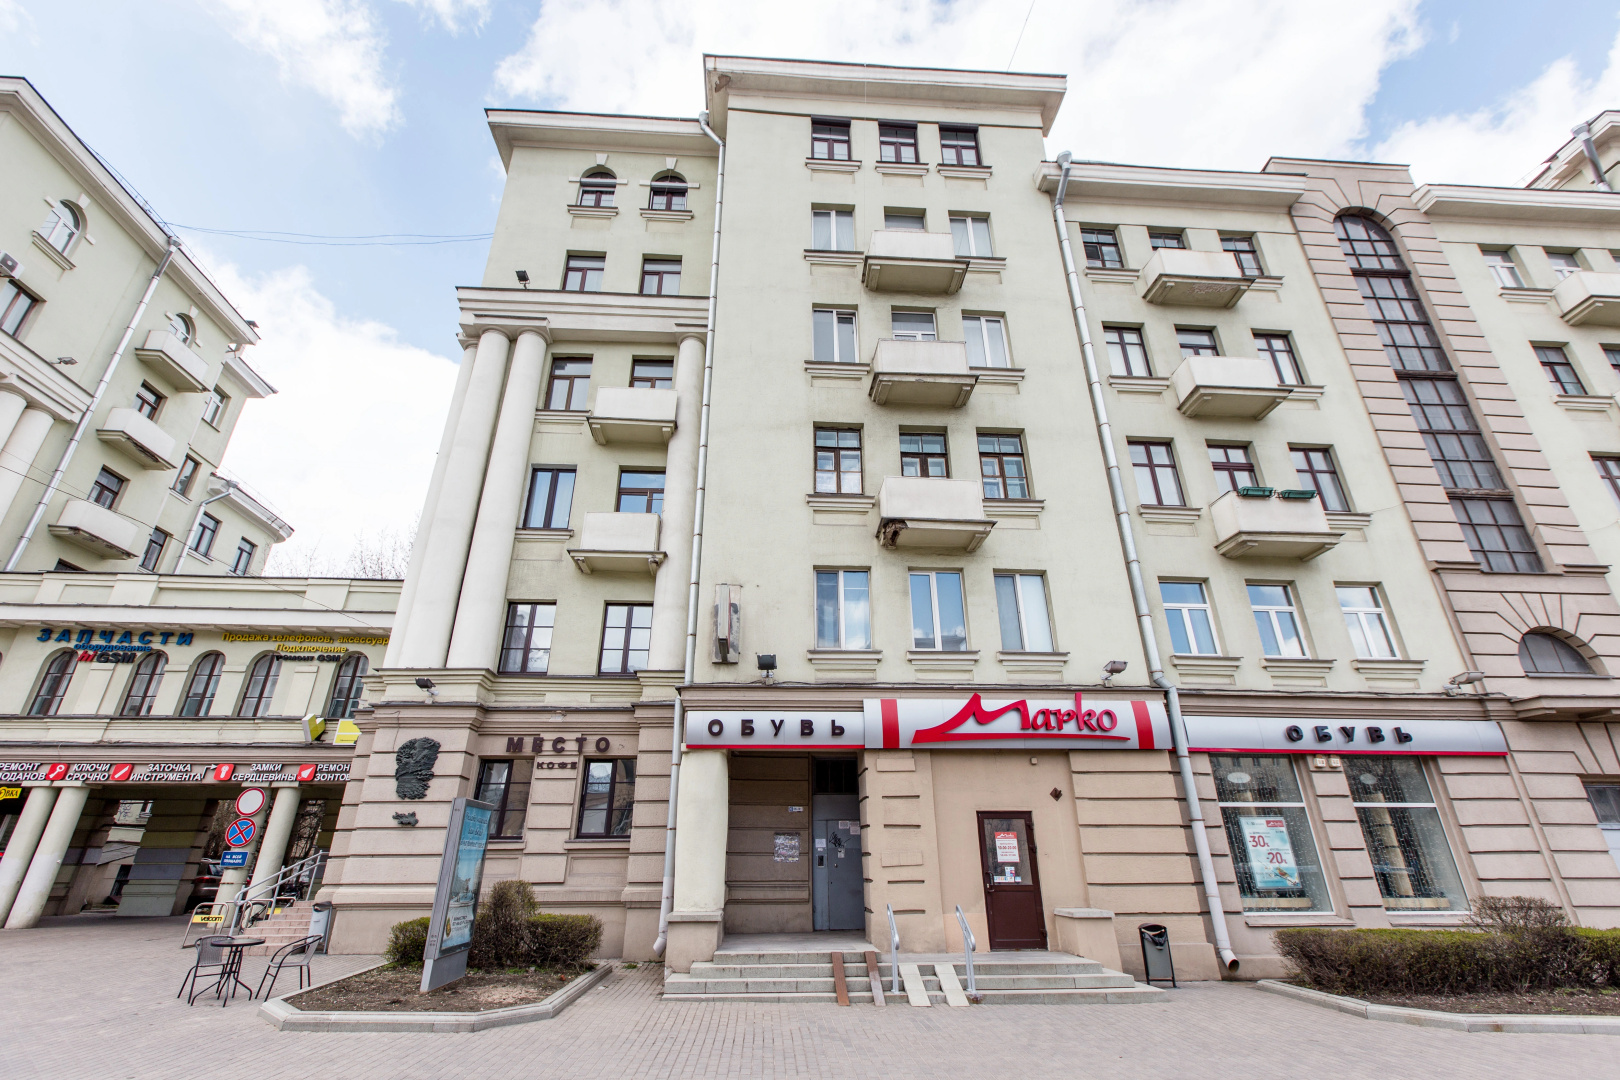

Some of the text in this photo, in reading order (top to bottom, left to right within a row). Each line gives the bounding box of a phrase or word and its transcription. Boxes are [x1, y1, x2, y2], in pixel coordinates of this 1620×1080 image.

[37, 628, 194, 645] ЗАПЧАСТИ
[222, 632, 269, 642] Продажа
[74, 643, 152, 652] оборудование
[275, 643, 347, 653] Подключение
[707, 719, 845, 737] ОБУВЬ
[1285, 725, 1413, 743] ОБУВЬ
[506, 736, 610, 753] МЕСТО
[73, 763, 111, 771] КЛЮЧИ
[147, 763, 191, 772] ЗАТОЧКА
[250, 763, 282, 772] ЗАМКИ
[537, 761, 578, 769] КОФЕ
[0, 772, 46, 781] ОДАНОВ
[65, 773, 109, 781] СРОЧНО
[130, 773, 201, 781] ИНСТРУМЕНТА
[231, 773, 296, 782] СЕРДЦЕВИНЫ
